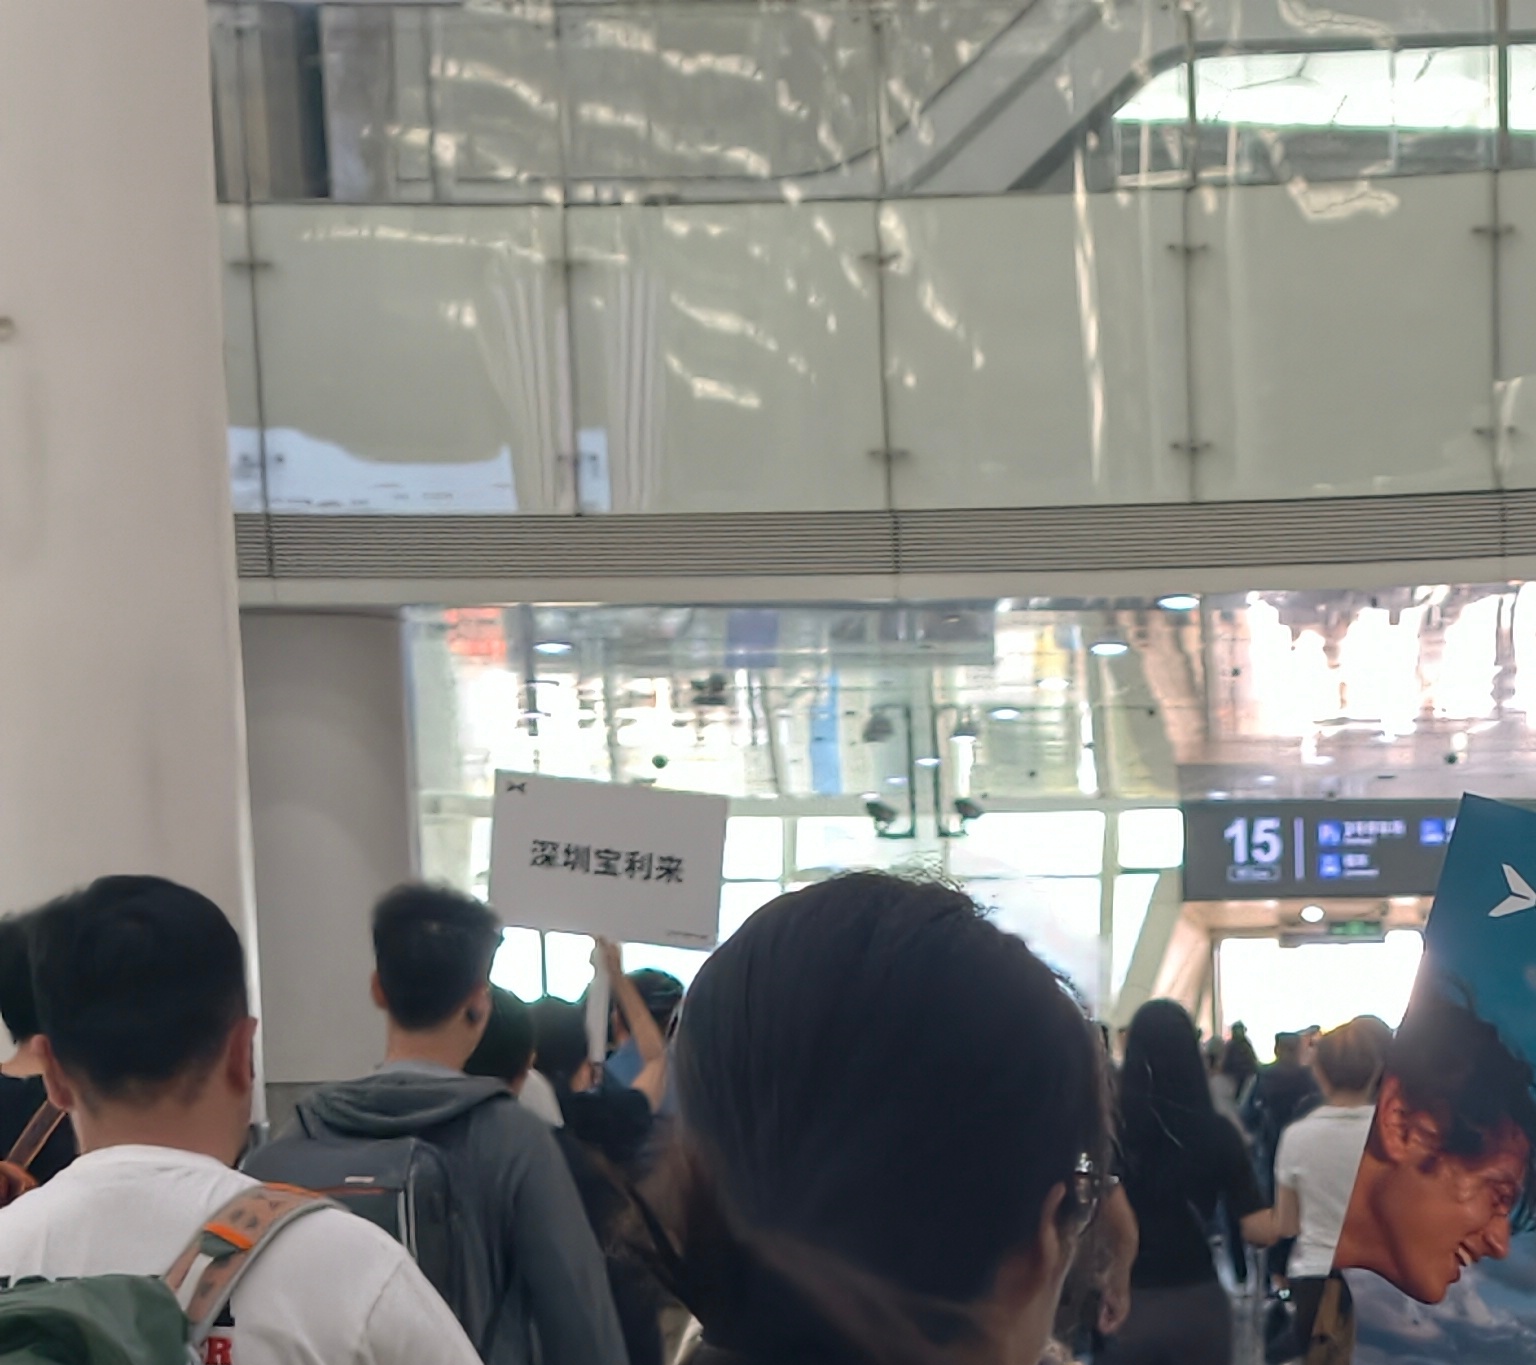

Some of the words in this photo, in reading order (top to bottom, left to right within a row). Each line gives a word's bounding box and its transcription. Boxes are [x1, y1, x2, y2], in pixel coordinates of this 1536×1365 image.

[529, 838, 684, 883] 深圳宝利来
[1224, 817, 1282, 864] 15
